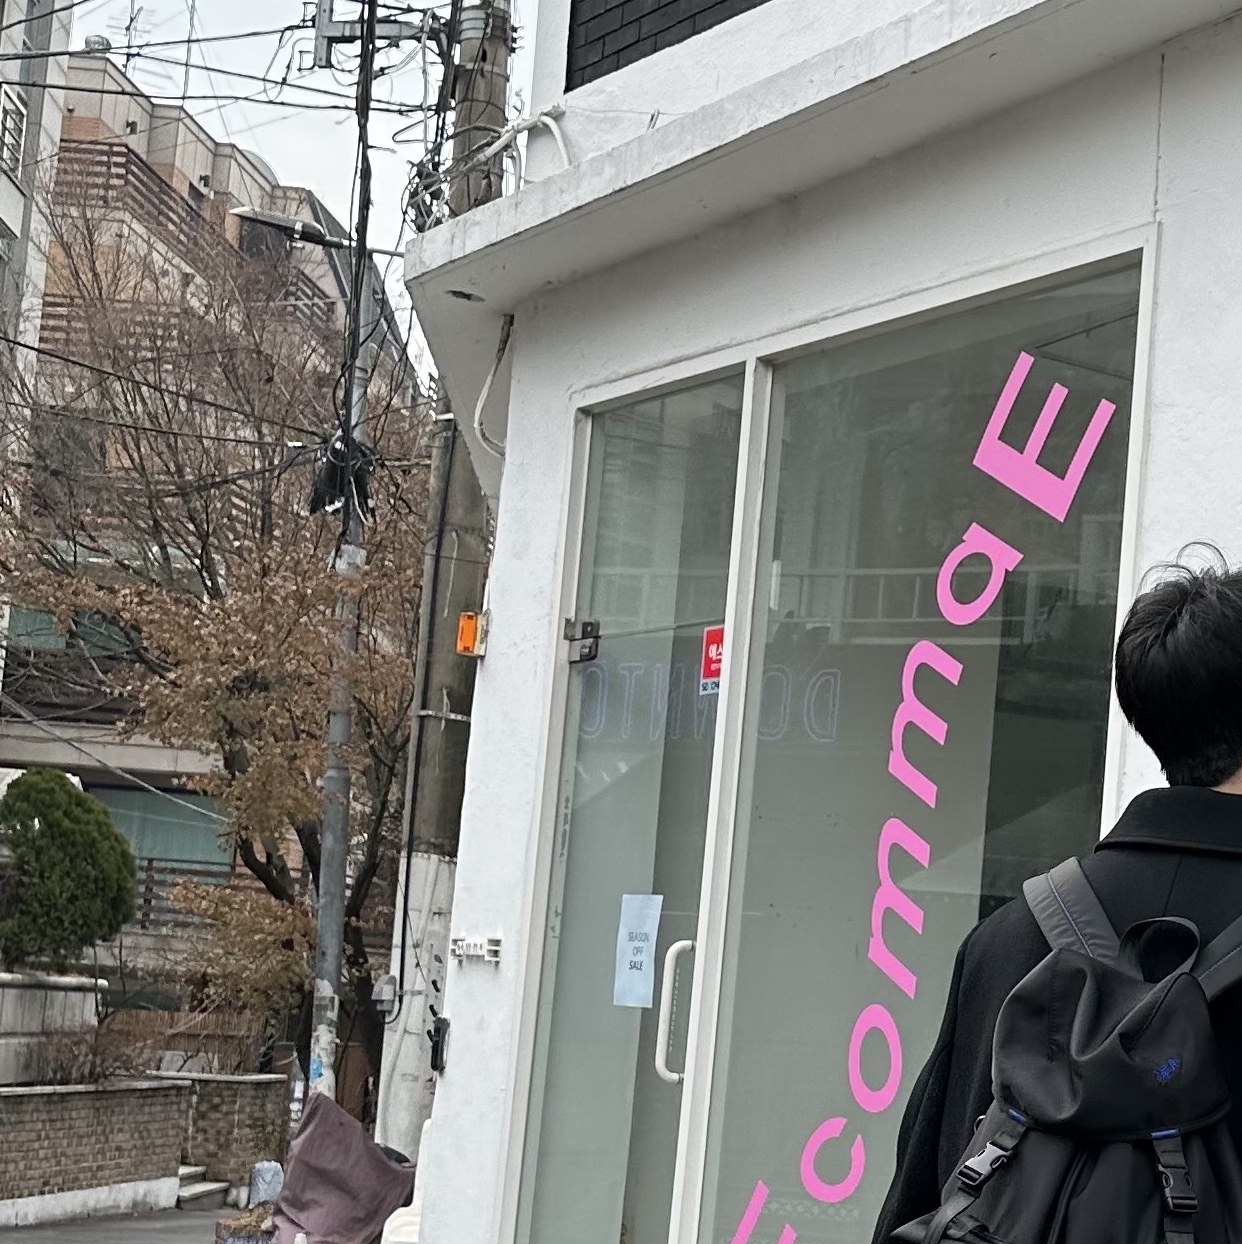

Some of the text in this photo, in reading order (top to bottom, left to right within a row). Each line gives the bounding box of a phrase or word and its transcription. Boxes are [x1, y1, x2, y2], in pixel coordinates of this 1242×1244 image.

[629, 931, 649, 942] SEASON
[633, 946, 644, 956] OFF
[629, 960, 644, 970] SALE
